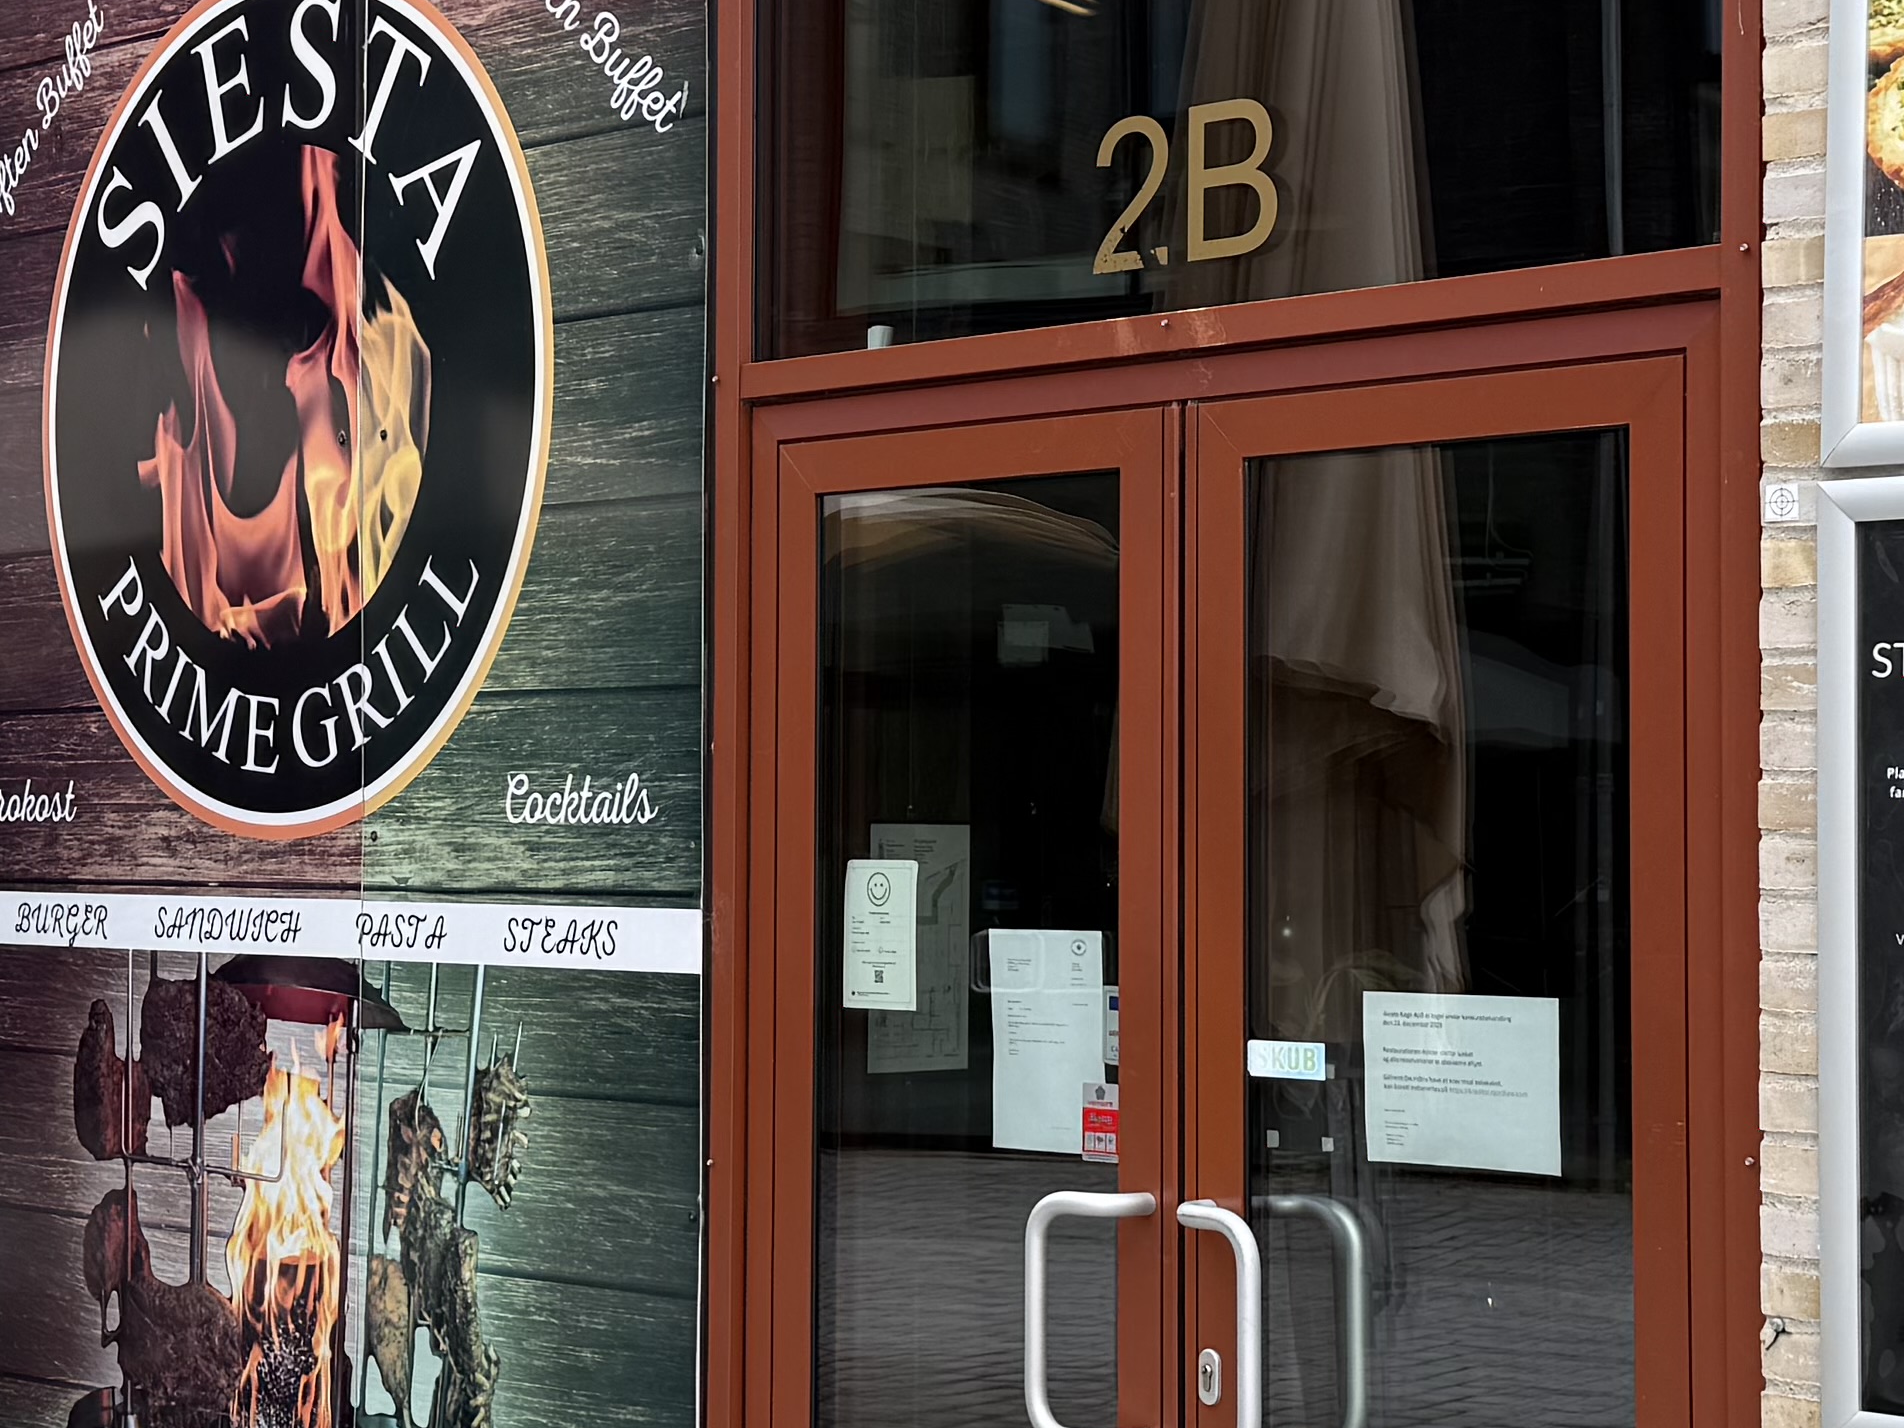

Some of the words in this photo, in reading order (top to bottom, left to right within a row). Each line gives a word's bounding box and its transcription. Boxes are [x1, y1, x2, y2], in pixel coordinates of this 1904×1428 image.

[580, 12, 682, 133] Buffet
[1093, 98, 1278, 274] 2B
[97, 555, 280, 775] PRIME
[292, 553, 480, 769] GRILL
[505, 772, 658, 825] Cocktails
[15, 902, 108, 947] BURGER
[154, 906, 302, 944] SANDWICH
[355, 912, 447, 951] PASTA
[503, 917, 618, 959] STEAKS
[1256, 1046, 1316, 1072] SKUB
